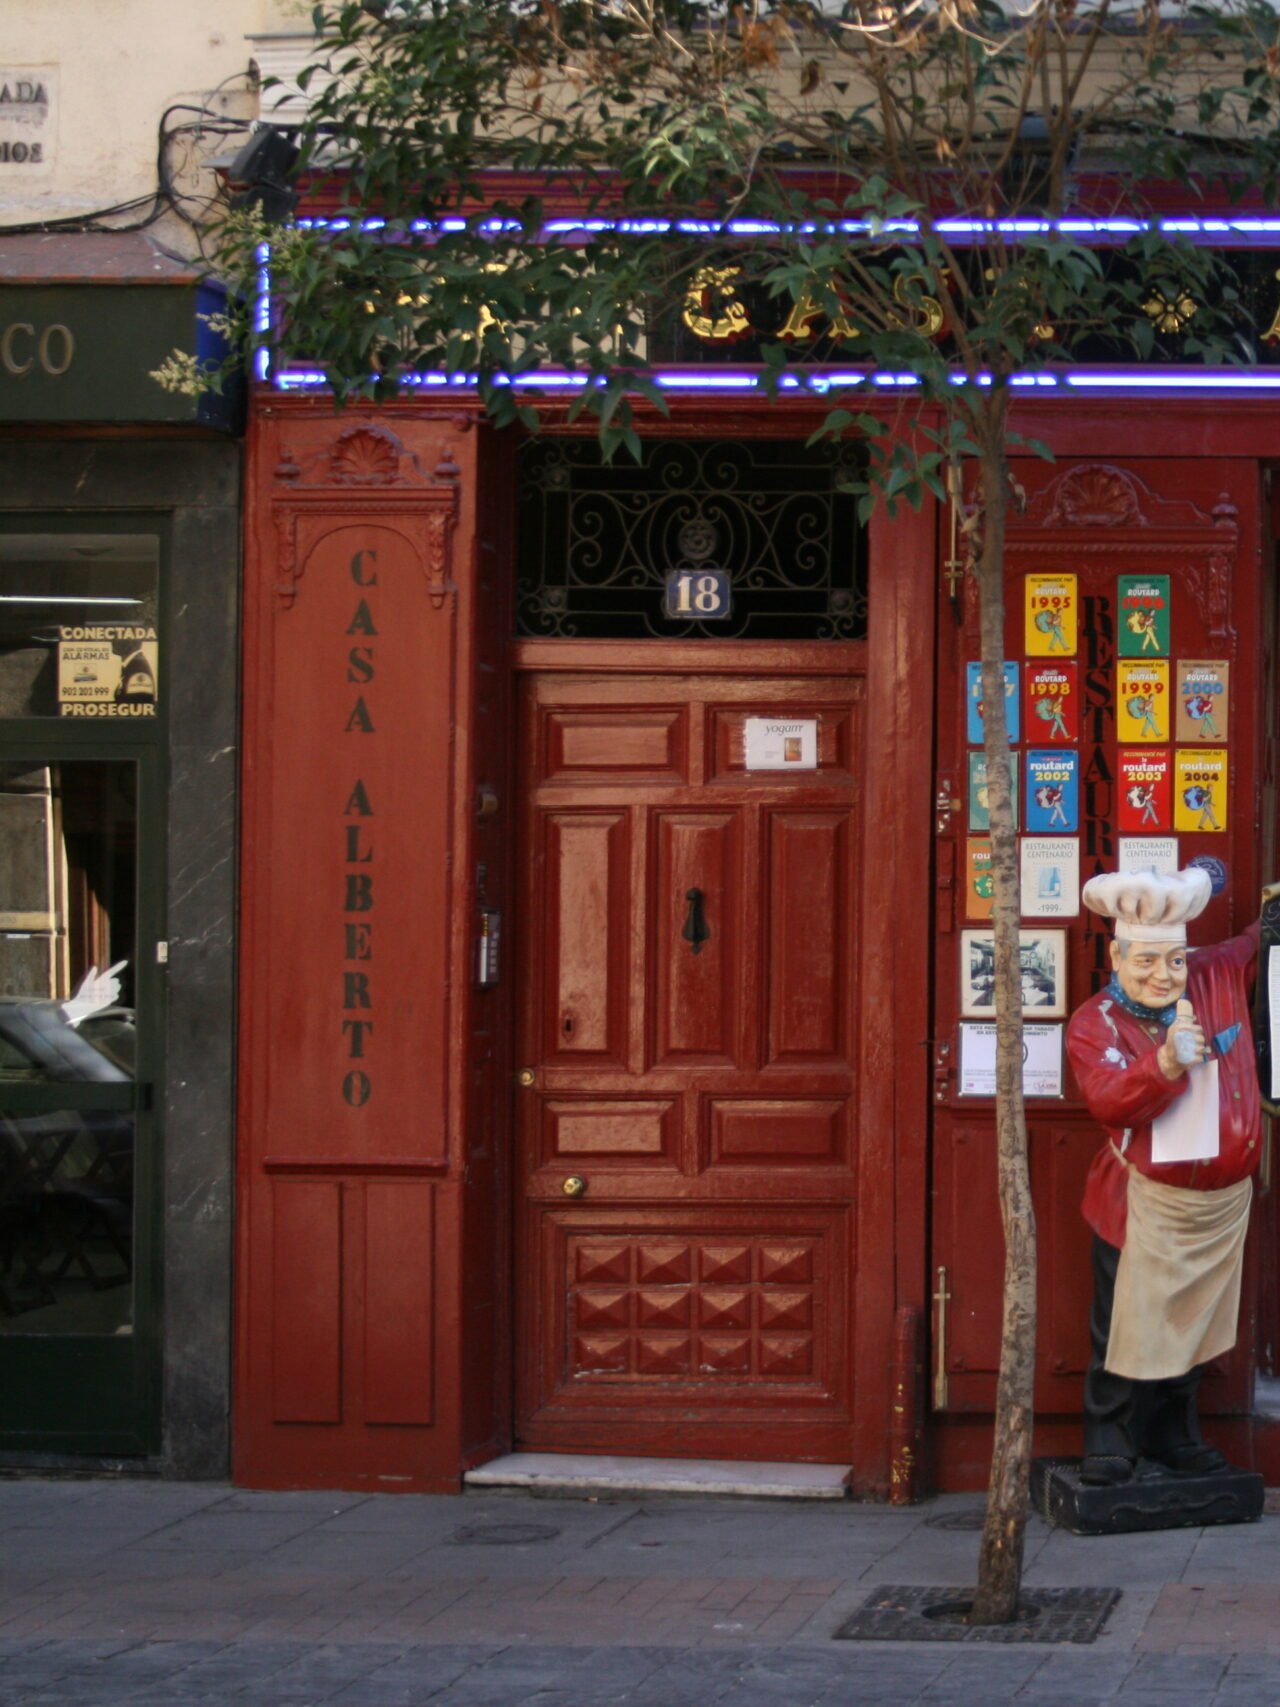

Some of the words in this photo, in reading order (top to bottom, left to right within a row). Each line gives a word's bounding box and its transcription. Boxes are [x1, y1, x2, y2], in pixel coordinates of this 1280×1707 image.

[677, 575, 721, 612] 18
[1127, 588, 1160, 597] ROUTARD
[1031, 597, 1071, 609] 1995
[62, 627, 157, 640] CONECTADA
[344, 549, 378, 734] CASA
[62, 652, 110, 660] ALARMAS
[1034, 675, 1067, 683] ROUTARD
[1127, 673, 1160, 681] ROUTARD
[1186, 673, 1219, 681] ROUTARD
[62, 687, 78, 696] 902
[95, 687, 109, 696] 999
[1030, 683, 1071, 695] 1998
[1121, 682, 1164, 695] 1999
[1182, 682, 1224, 695] 2000
[62, 703, 156, 716] PROSEGUR
[1030, 761, 1074, 771] routard
[1122, 763, 1167, 772] routard
[1179, 762, 1222, 771] routard
[1035, 771, 1070, 782] 2002
[1127, 772, 1162, 782] 2003
[1184, 772, 1220, 782] 2004
[1025, 843, 1075, 851] RESTAURANTE
[1123, 841, 1173, 850] RESTAURANTE
[1026, 850, 1073, 859] CENTENARIO
[1125, 849, 1172, 858] CENTENARIO
[340, 778, 375, 1108] ALBERTO
